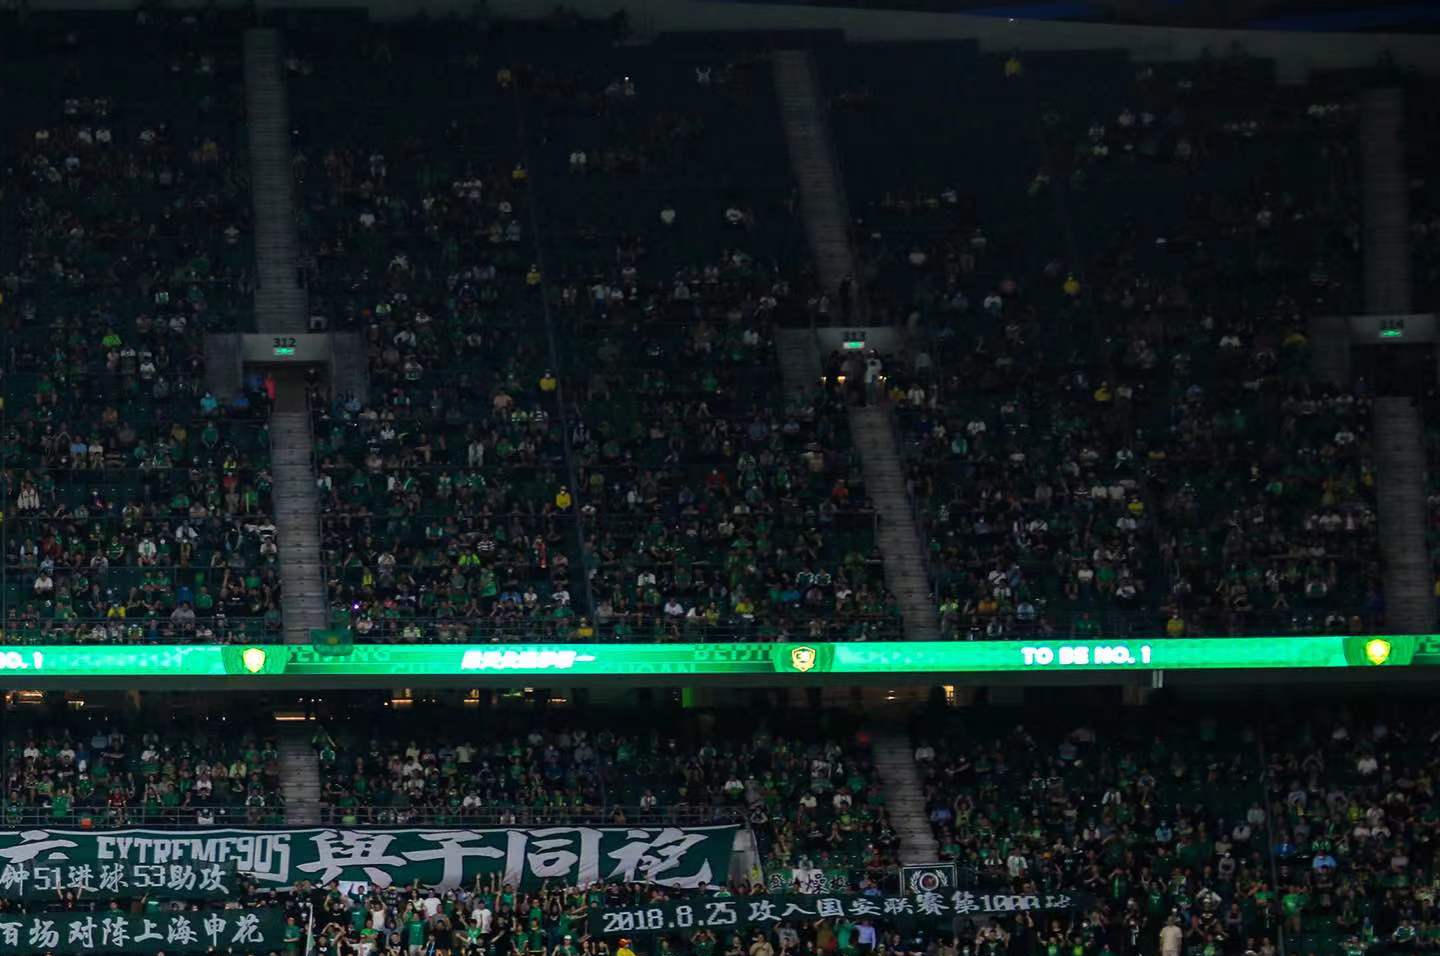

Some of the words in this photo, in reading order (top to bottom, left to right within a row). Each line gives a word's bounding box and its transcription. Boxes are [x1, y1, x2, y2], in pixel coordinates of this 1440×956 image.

[273, 338, 296, 347] 312
[33, 651, 44, 669] 1
[1021, 646, 1053, 665] TO
[1059, 646, 1089, 665] BE
[1094, 645, 1135, 665] NO.
[1140, 645, 1151, 664] 1
[603, 903, 738, 933] 2018.8.25
